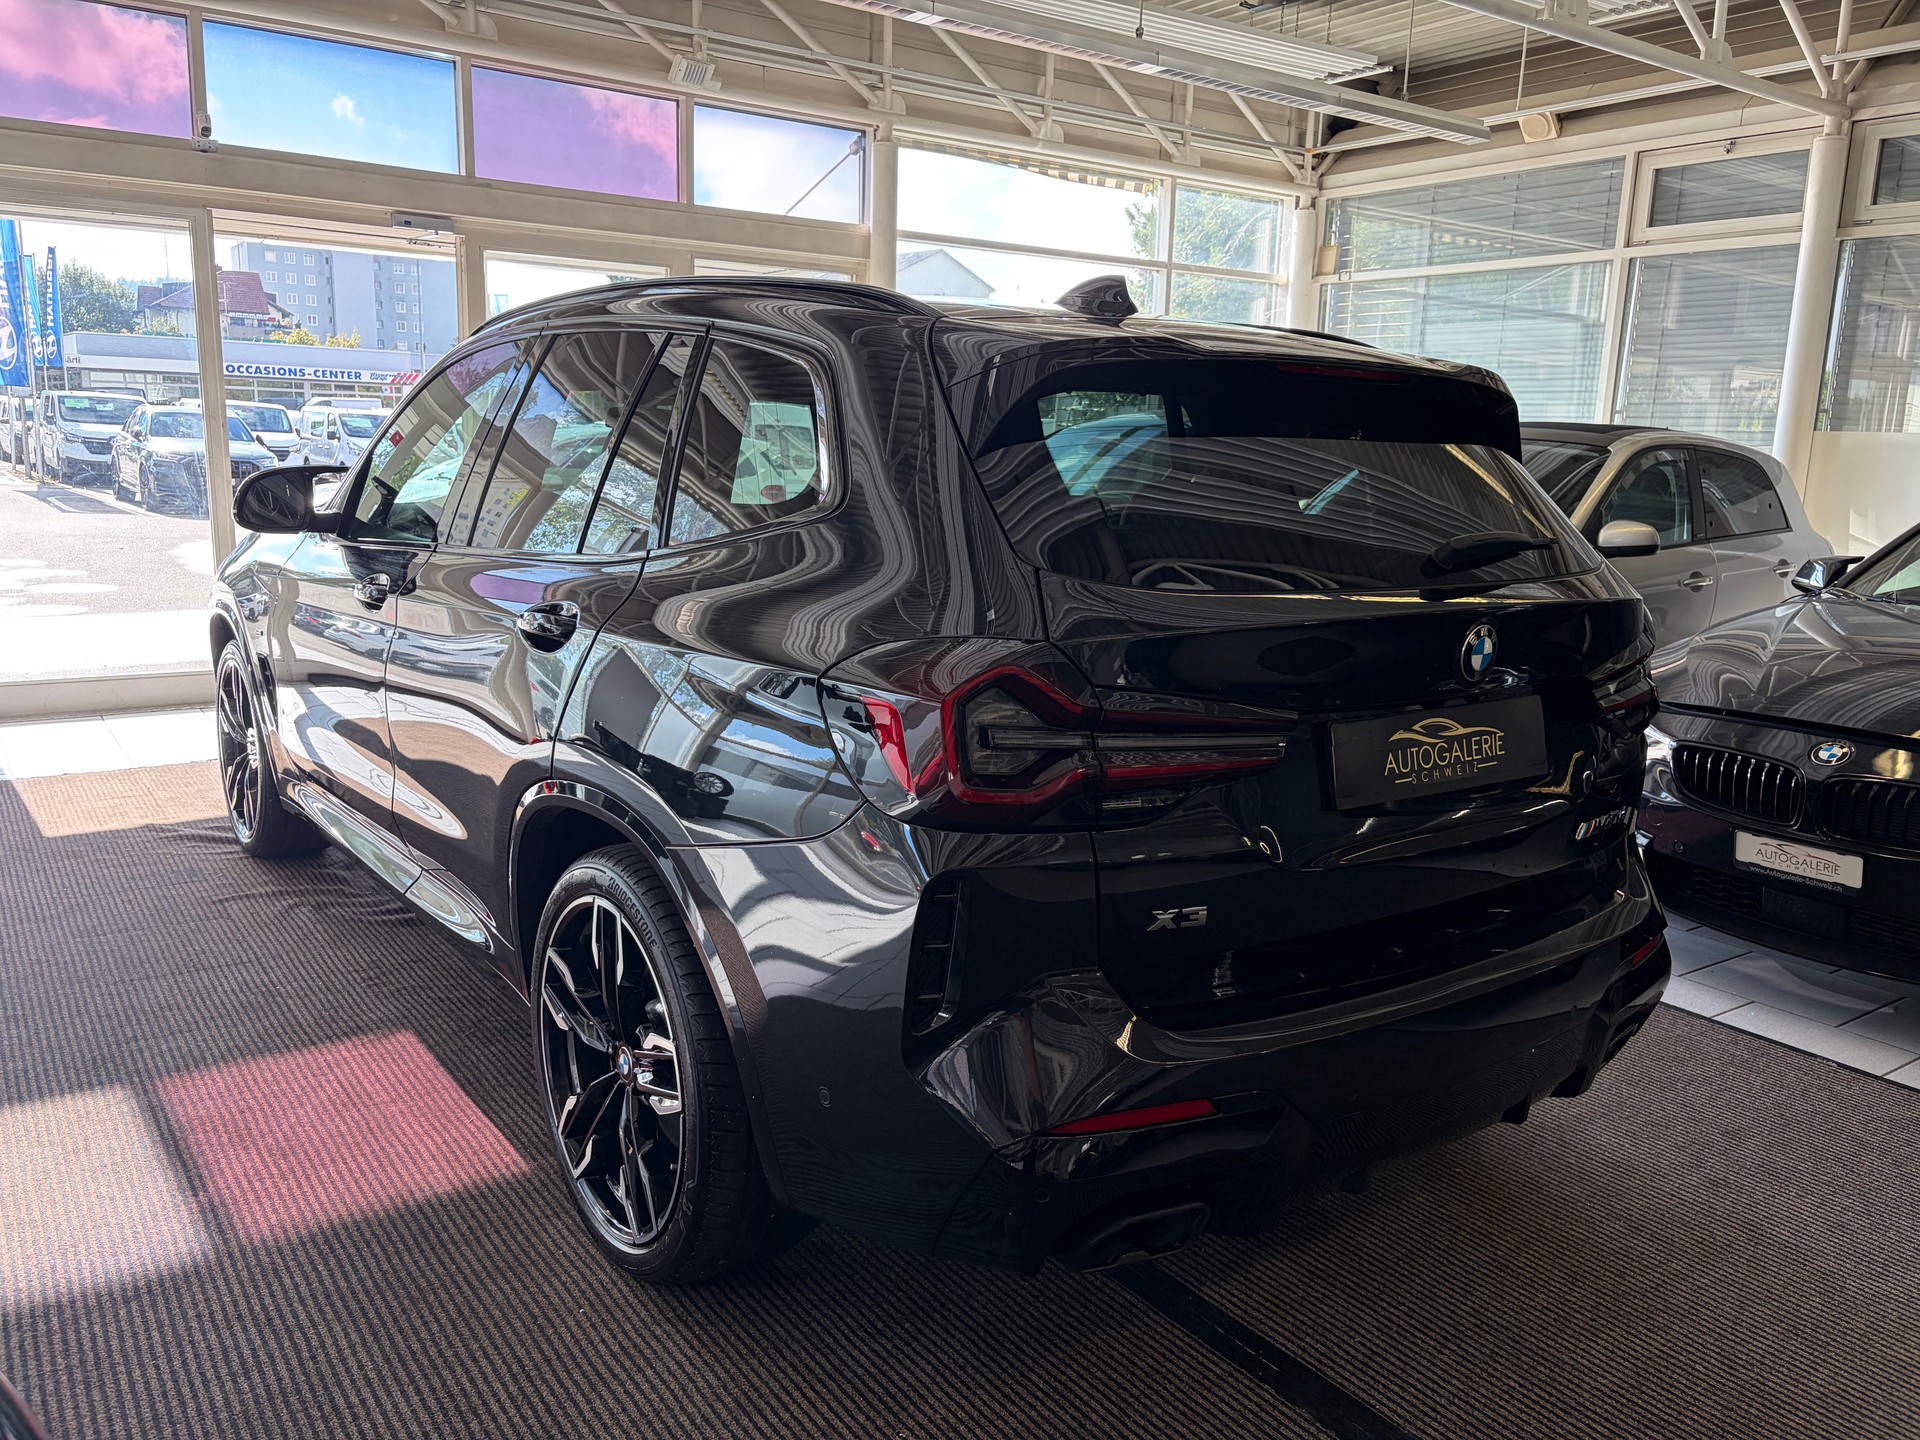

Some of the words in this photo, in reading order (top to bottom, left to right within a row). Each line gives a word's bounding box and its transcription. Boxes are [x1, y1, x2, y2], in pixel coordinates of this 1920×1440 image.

[46, 254, 54, 327] HYUNDAI
[225, 364, 362, 381] OCCASIONS-CENTER
[1384, 732, 1506, 777] AUTOGALERIE
[1411, 761, 1480, 785] SCHWEIZ
[1755, 848, 1842, 876] AUTOGALERIE
[1771, 860, 1820, 876] SCHWEIZ
[1749, 865, 1843, 893] www.Autogalerie-Schweiz.ch
[607, 876, 658, 949] BRIDGESTONE
[1146, 906, 1208, 931] X3
